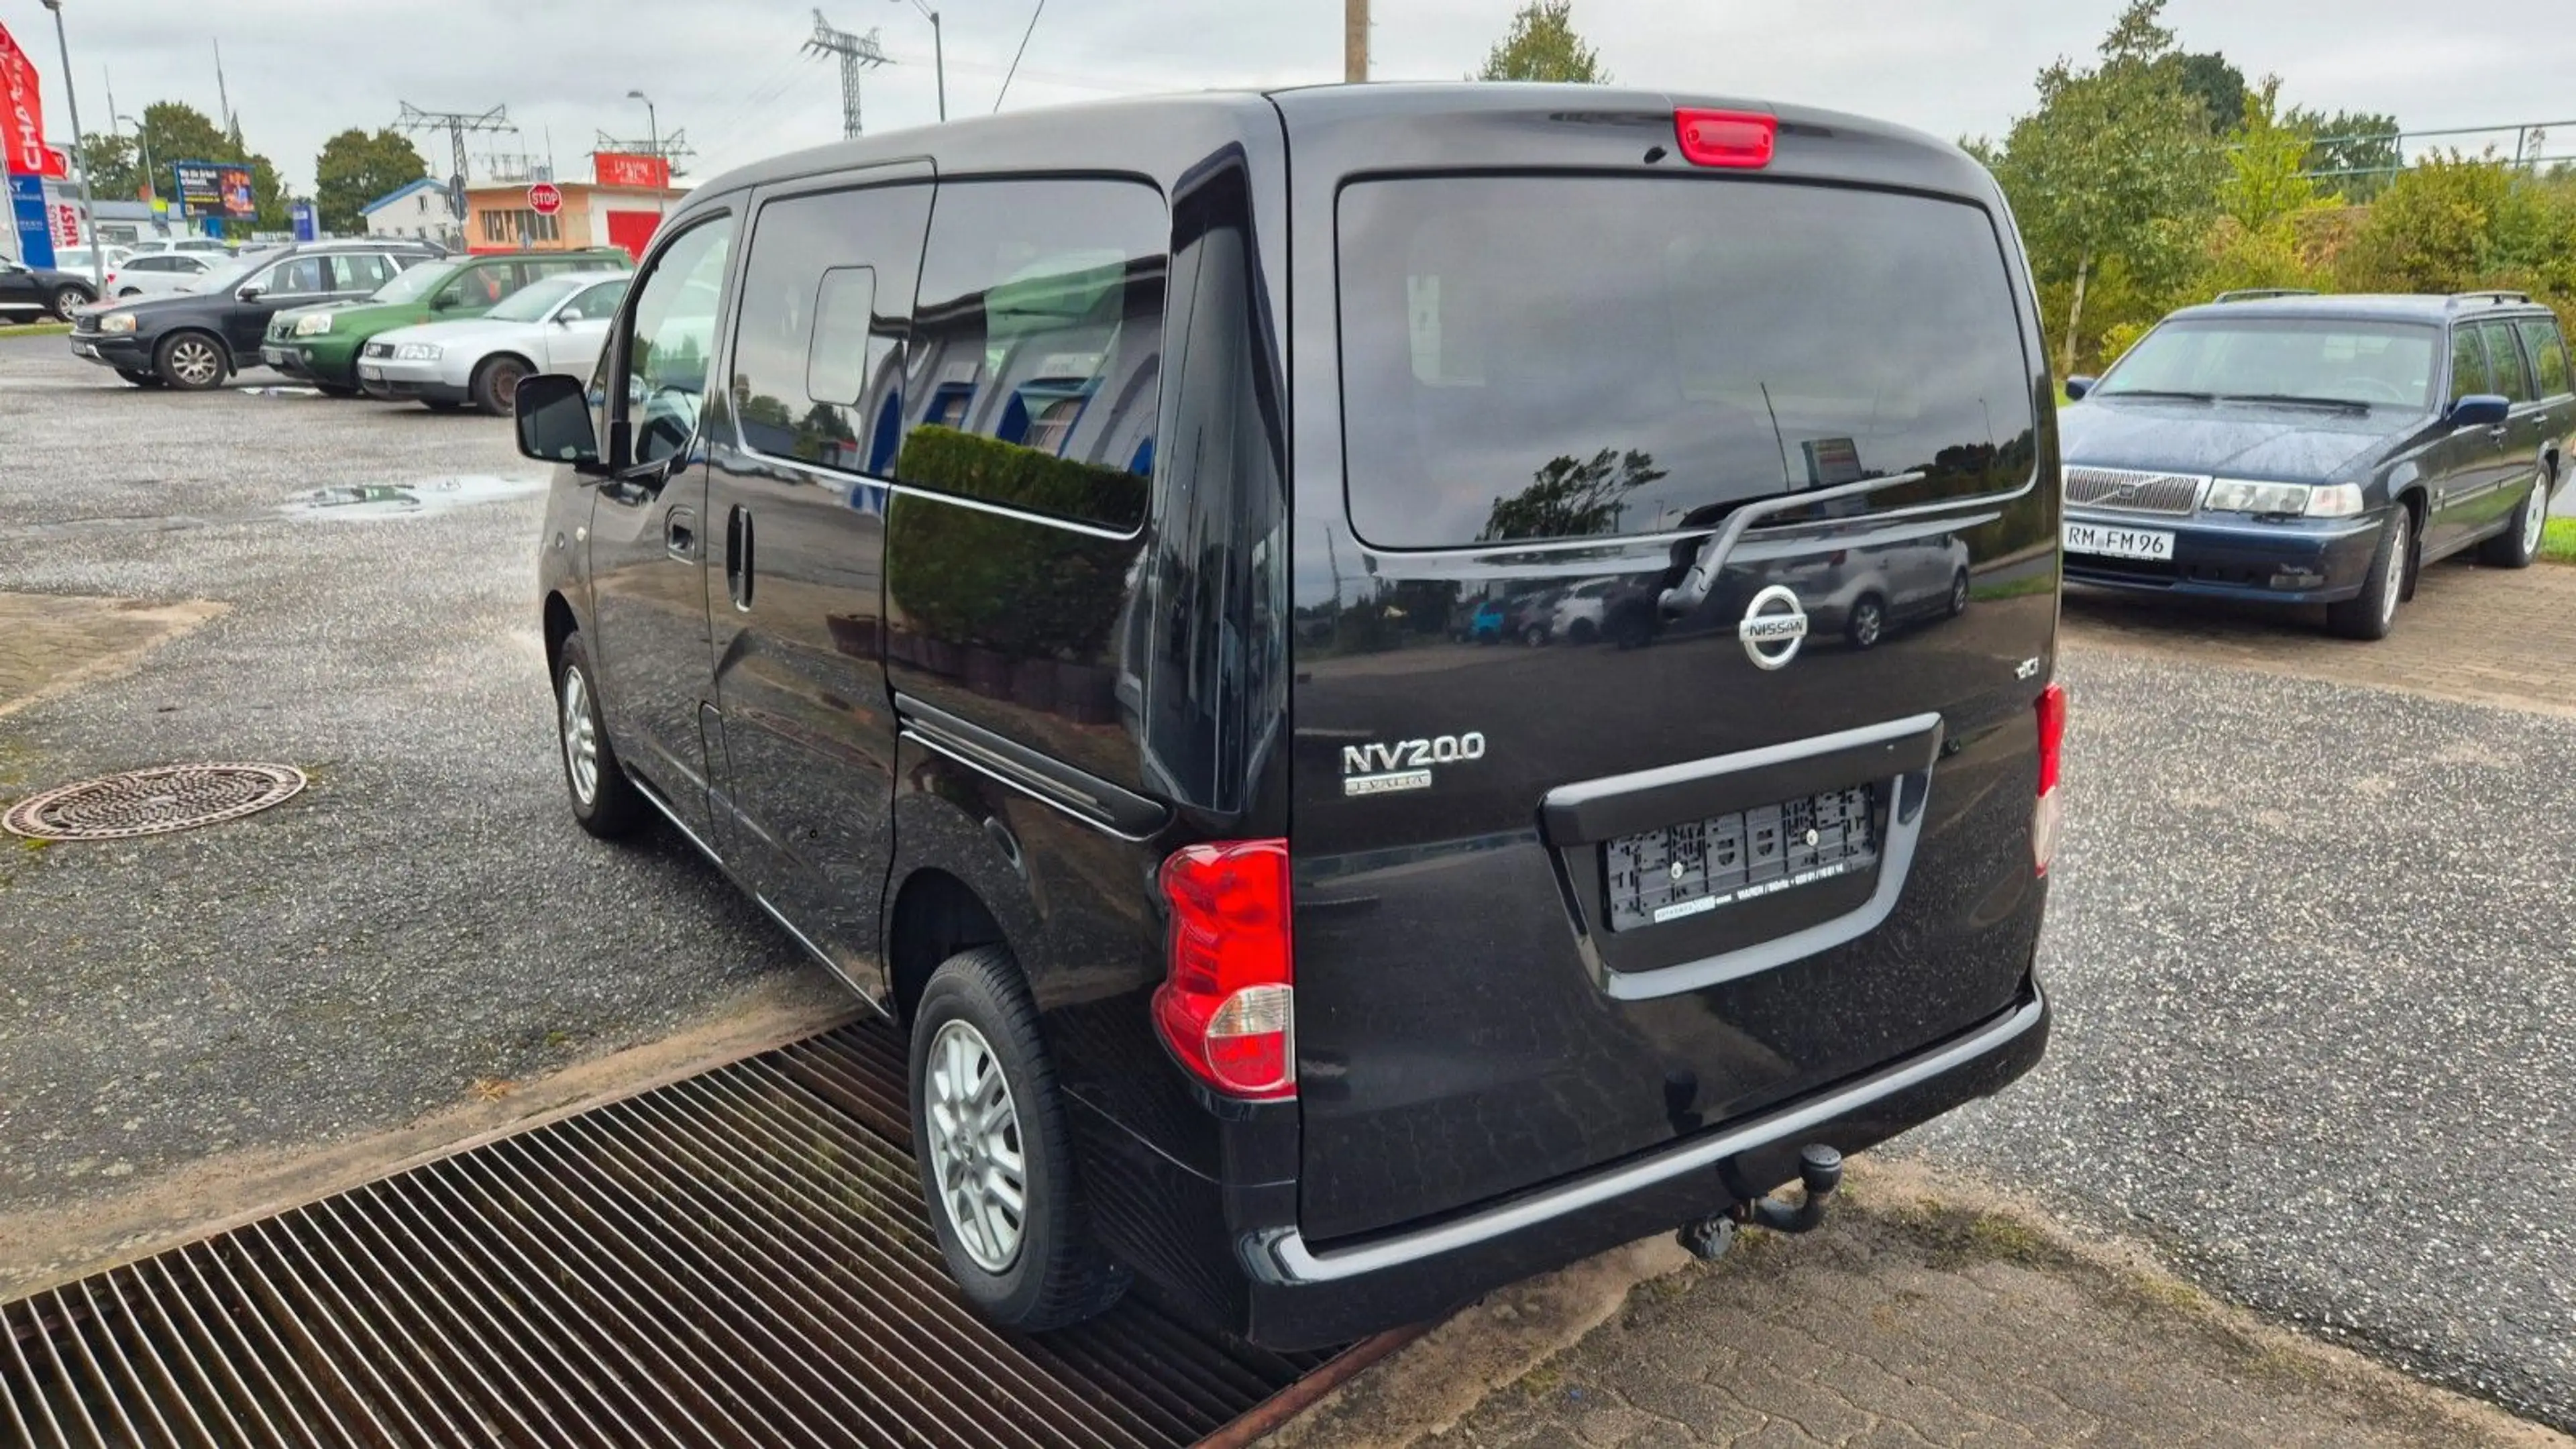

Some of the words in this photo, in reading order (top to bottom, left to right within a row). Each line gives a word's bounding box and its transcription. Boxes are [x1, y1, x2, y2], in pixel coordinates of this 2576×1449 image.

[532, 193, 558, 205] STOP
[2069, 527, 2096, 546] RM
[2105, 531, 2135, 550] FM
[2139, 534, 2164, 553] 96
[1750, 619, 1803, 636] NISSAN
[1344, 731, 1485, 773] NV200
